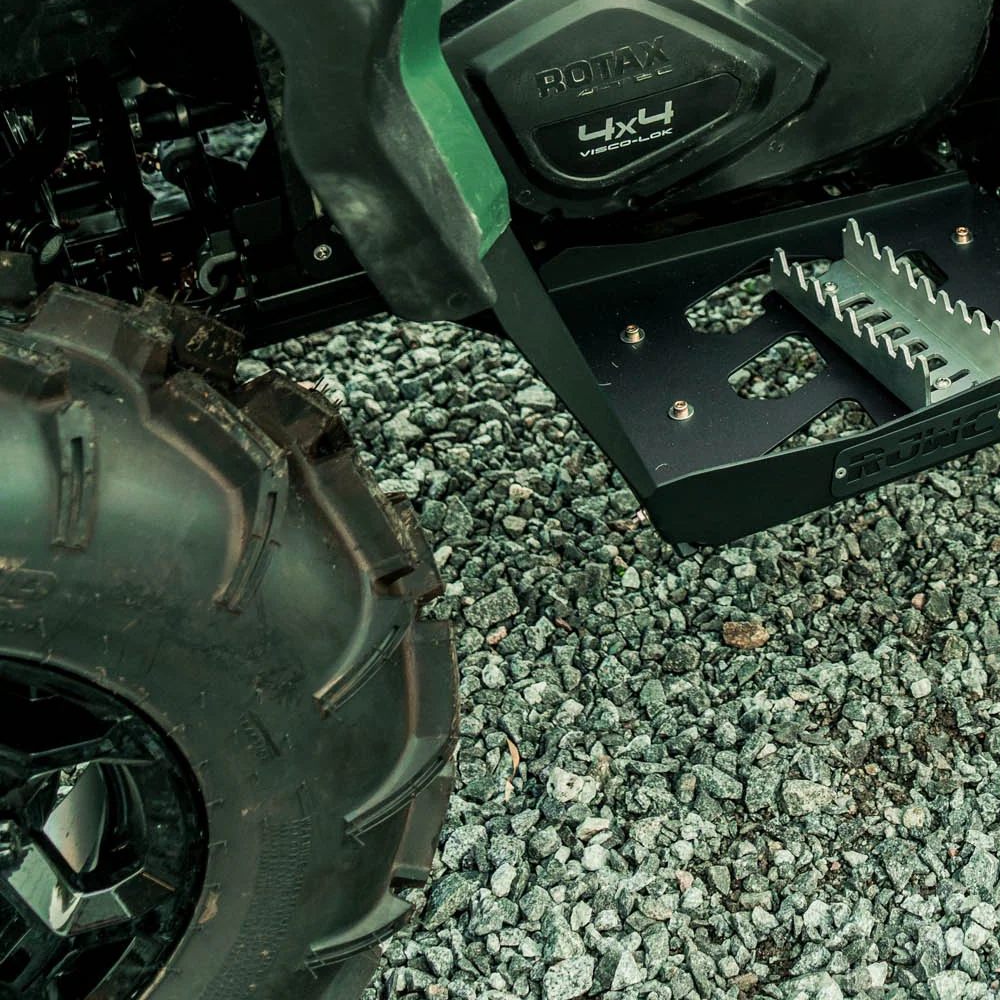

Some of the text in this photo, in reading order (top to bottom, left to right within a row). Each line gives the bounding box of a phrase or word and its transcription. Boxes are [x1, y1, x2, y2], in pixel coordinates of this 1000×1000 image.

[535, 34, 670, 98] ROTAX
[578, 100, 675, 142] 4x4
[579, 127, 673, 158] VISCO-LOK
